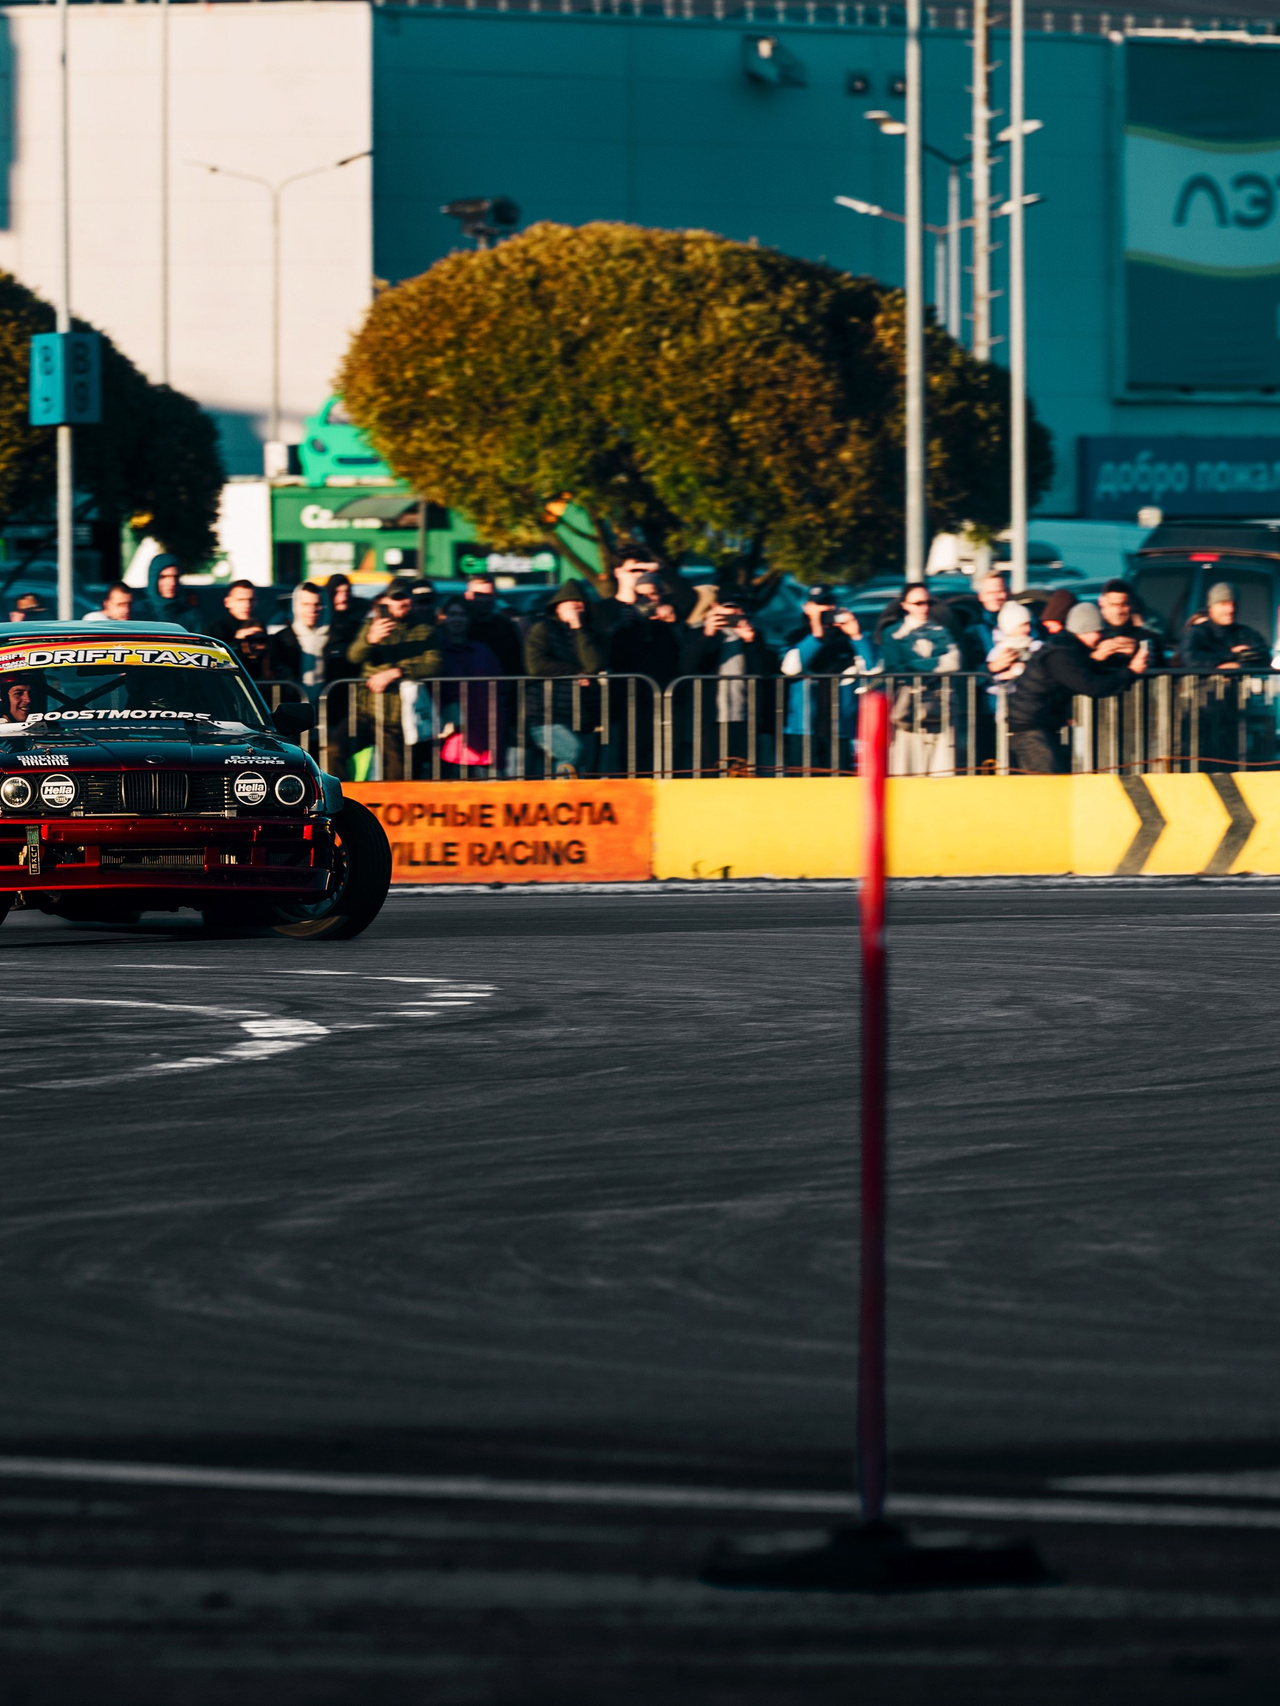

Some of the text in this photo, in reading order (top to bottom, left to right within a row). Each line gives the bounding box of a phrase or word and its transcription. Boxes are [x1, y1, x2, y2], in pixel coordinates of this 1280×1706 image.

[1173, 171, 1280, 231] ЛЭ
[28, 649, 132, 667] DRIFT
[136, 649, 210, 668] TAXI
[25, 708, 212, 723] BOOSTMOTORS
[43, 786, 73, 795] Hella
[237, 783, 265, 792] Hella
[502, 801, 618, 828] МАСЛА
[466, 839, 587, 867] RACING
